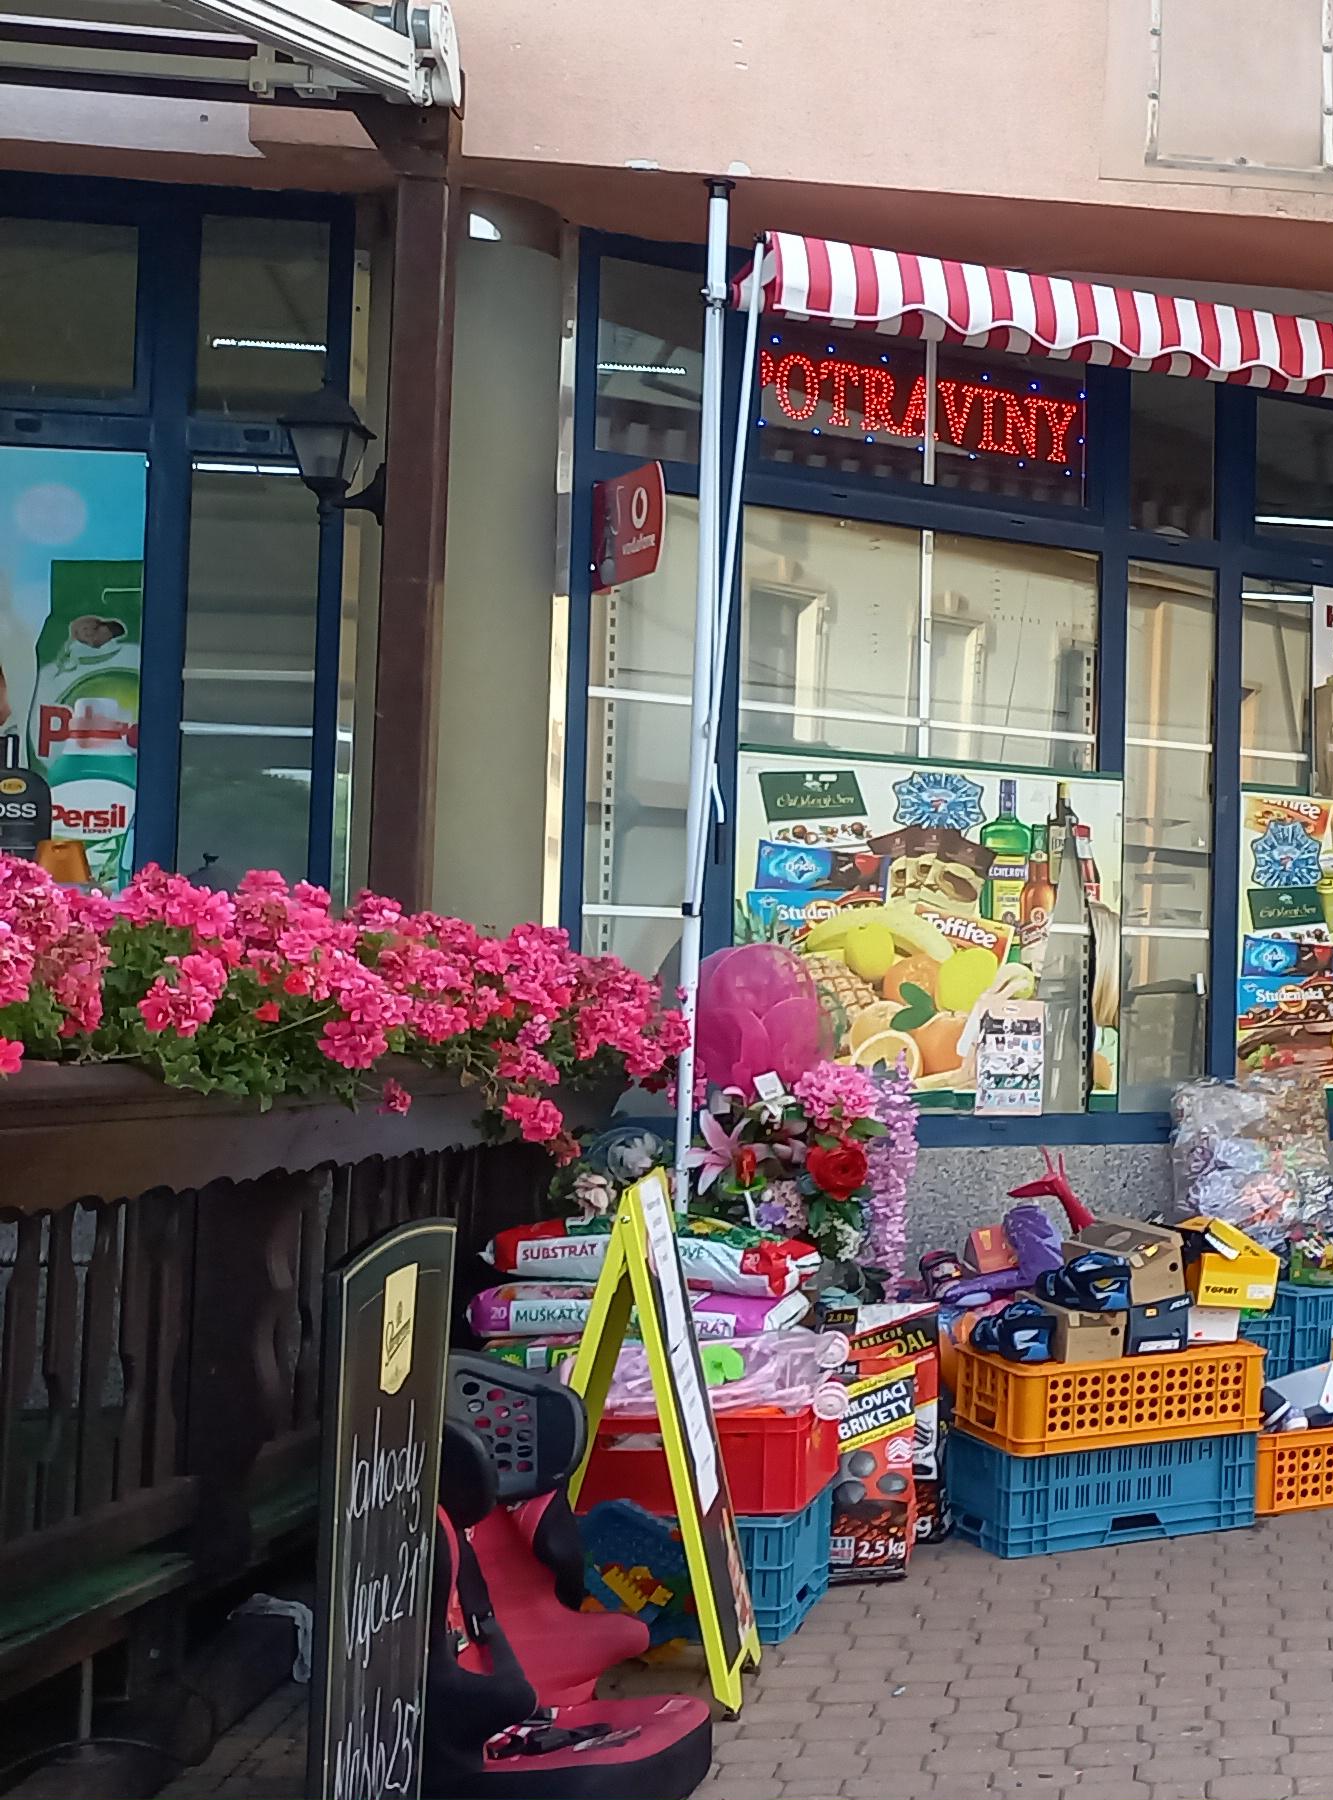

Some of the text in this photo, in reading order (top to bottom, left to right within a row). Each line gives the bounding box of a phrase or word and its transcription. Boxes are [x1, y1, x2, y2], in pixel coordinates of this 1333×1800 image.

[52, 803, 126, 829] Persil
[521, 1242, 598, 1261] SUBSTRÁT
[489, 1308, 508, 1321] 20
[837, 1397, 913, 1440] BRIKETY
[858, 1538, 906, 1560] 2,5 kg
